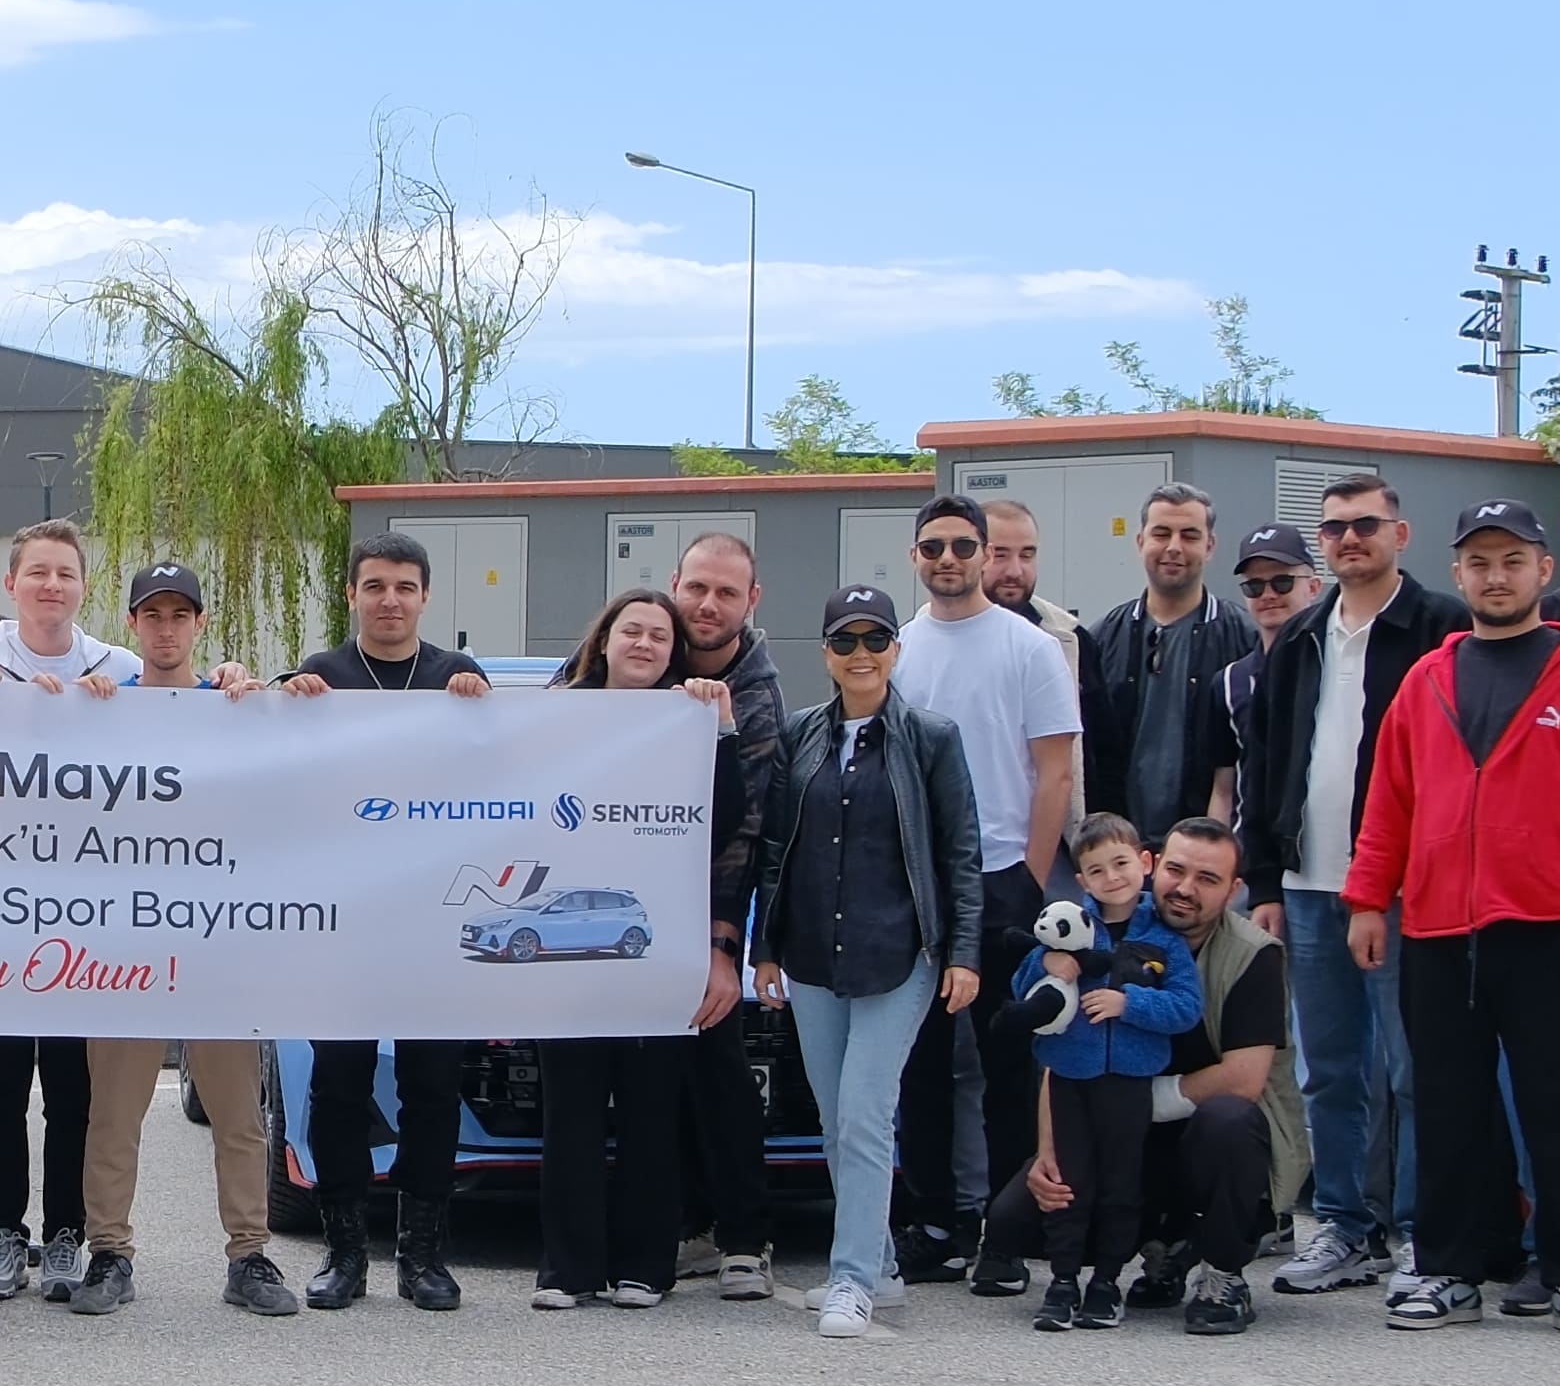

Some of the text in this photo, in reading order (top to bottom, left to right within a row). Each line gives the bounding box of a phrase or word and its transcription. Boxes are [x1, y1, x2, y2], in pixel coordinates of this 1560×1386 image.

[407, 800, 535, 821] HYUNDAI
[73, 825, 237, 875] Anma,
[0, 886, 117, 935] Spor
[131, 889, 338, 939] Bayramı
[22, 937, 159, 993] Olsun
